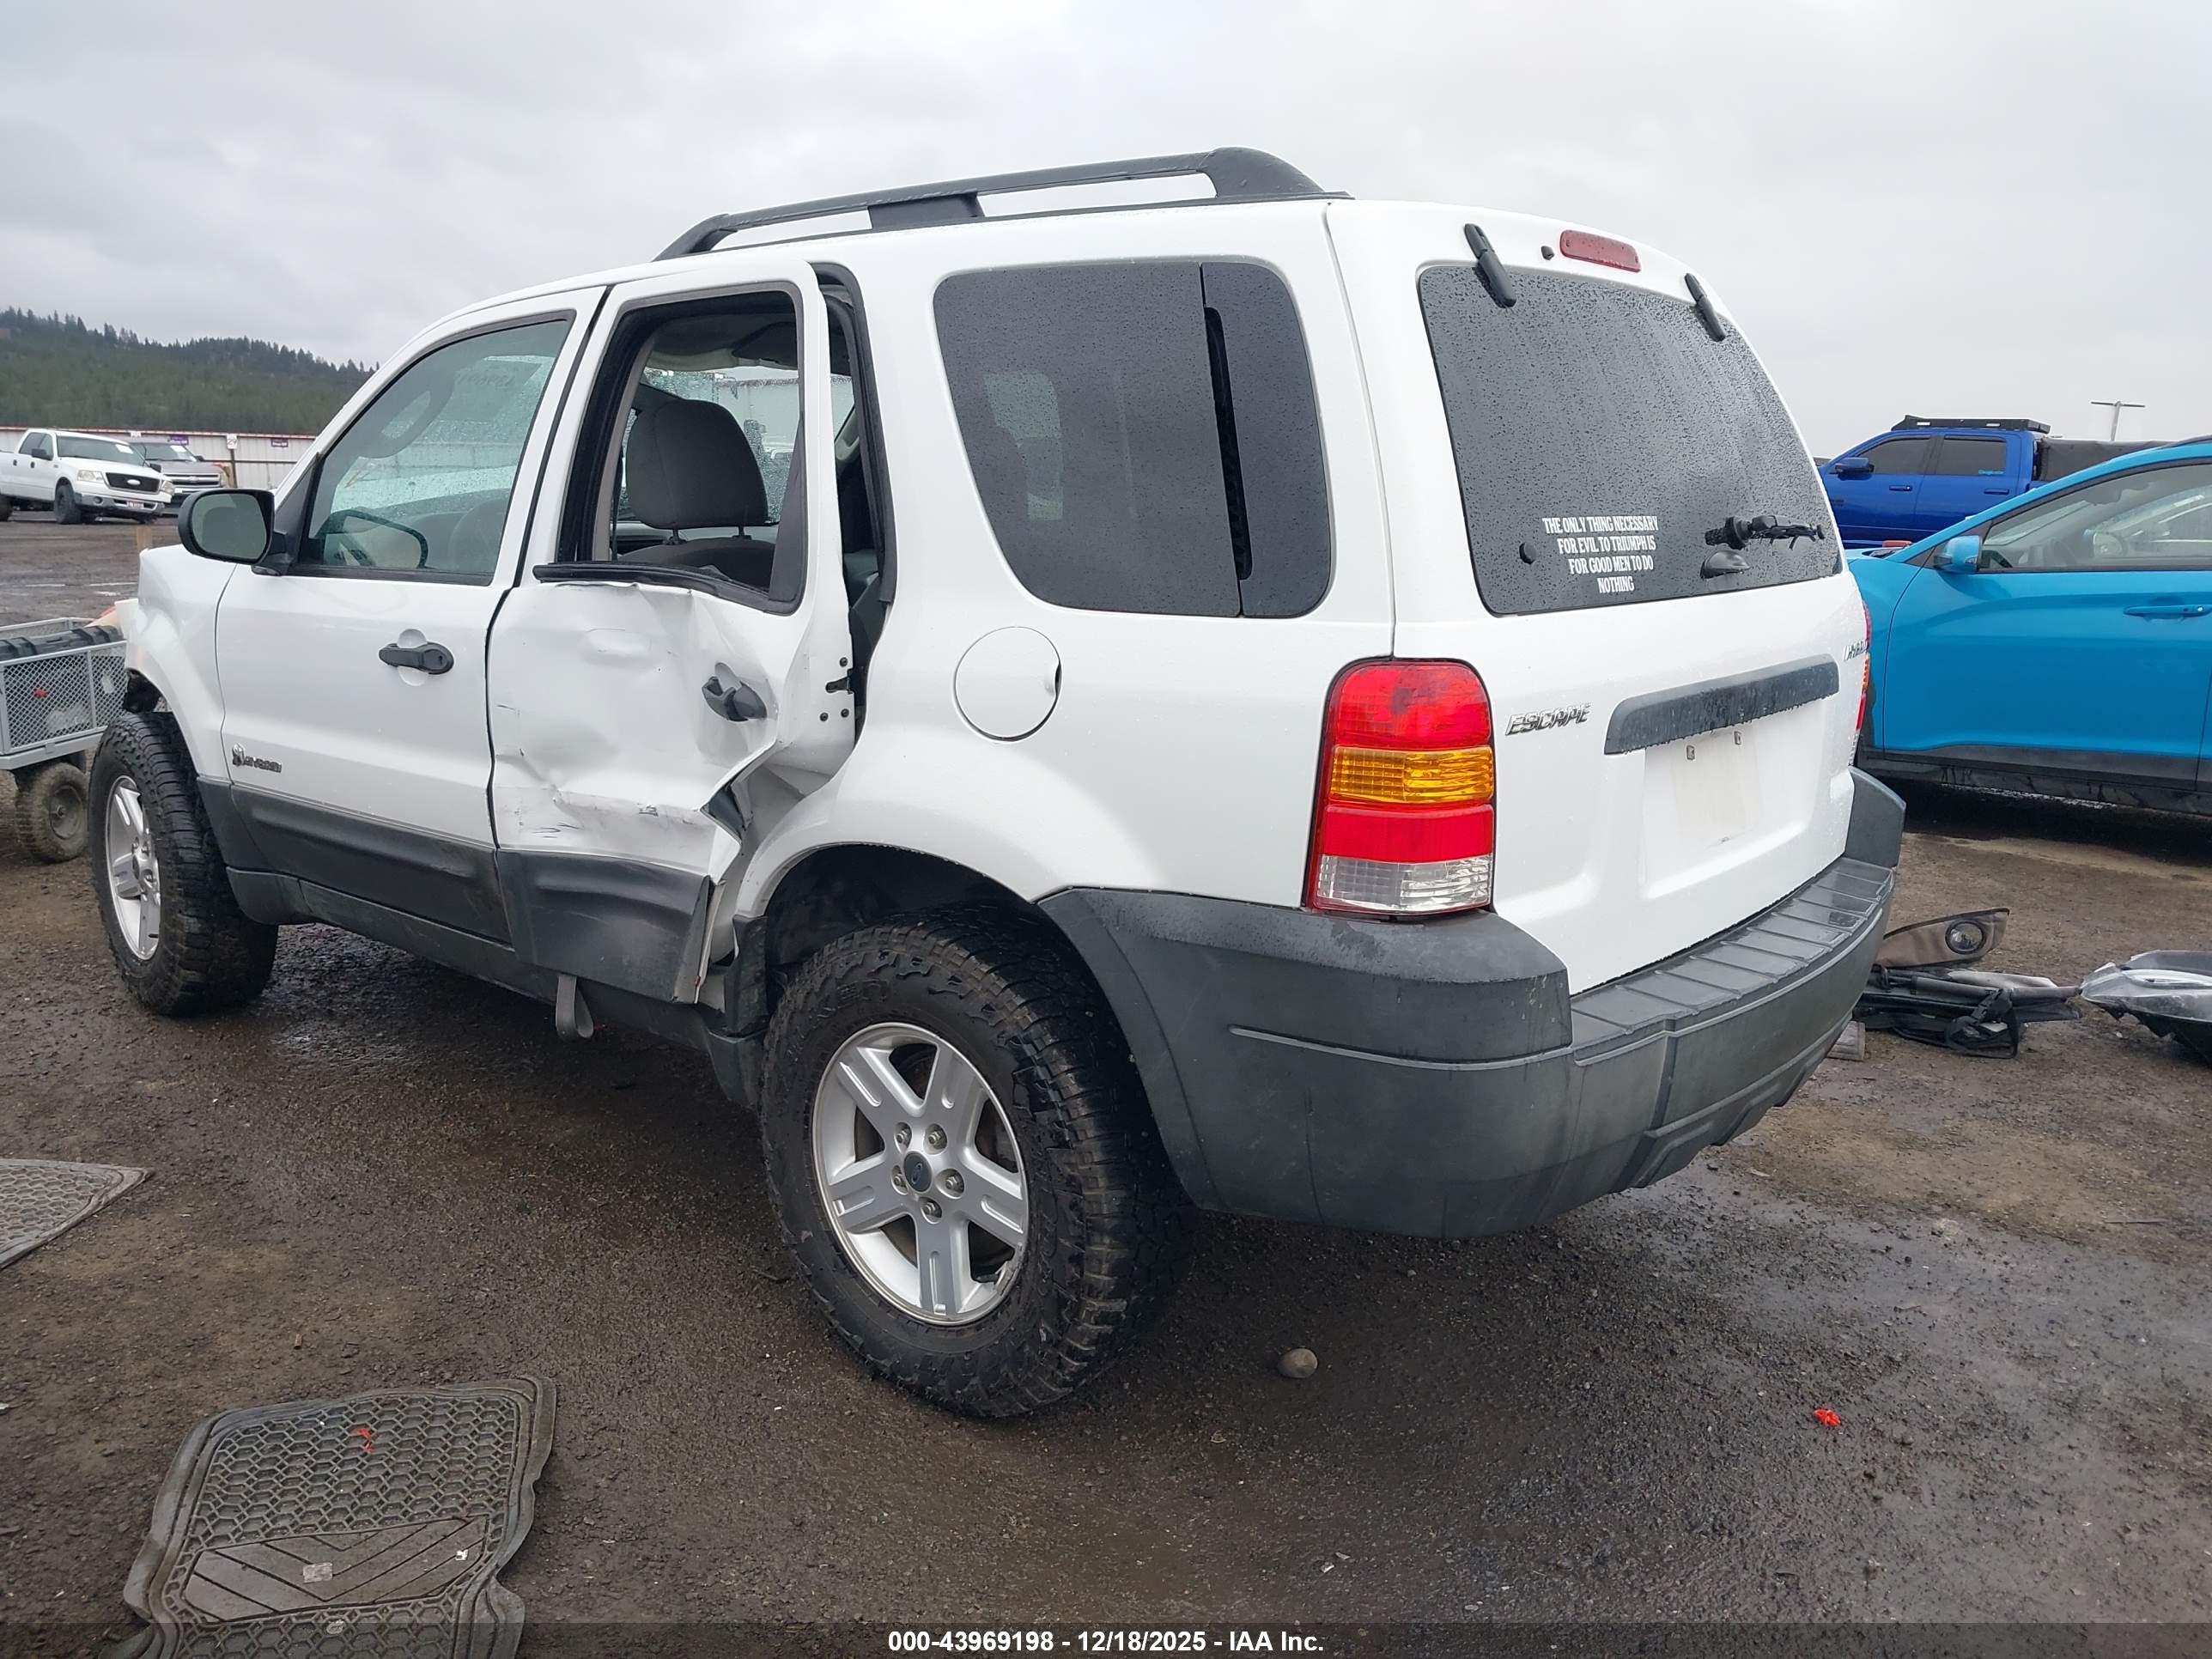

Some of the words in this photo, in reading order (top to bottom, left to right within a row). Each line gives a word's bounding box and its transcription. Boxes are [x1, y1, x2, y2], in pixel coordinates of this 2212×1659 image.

[1542, 517, 1563, 534] THE
[1563, 516, 1586, 533] ONLY
[1586, 516, 1614, 532] THING
[1613, 515, 1659, 532] NECESSARY
[1557, 538, 1578, 554] FOR
[1577, 537, 1599, 553] EVIL
[1598, 536, 1611, 552] TO
[1610, 535, 1648, 551] TRIUMPH
[1646, 534, 1656, 550] IS
[1568, 558, 1589, 574] FOR
[1589, 556, 1613, 574] GOOD
[1613, 556, 1632, 572] MEN
[1631, 555, 1642, 571] TO
[1641, 555, 1654, 570] DO
[1597, 576, 1635, 594] NOTHING
[1504, 702, 1592, 736] ESCAPE
